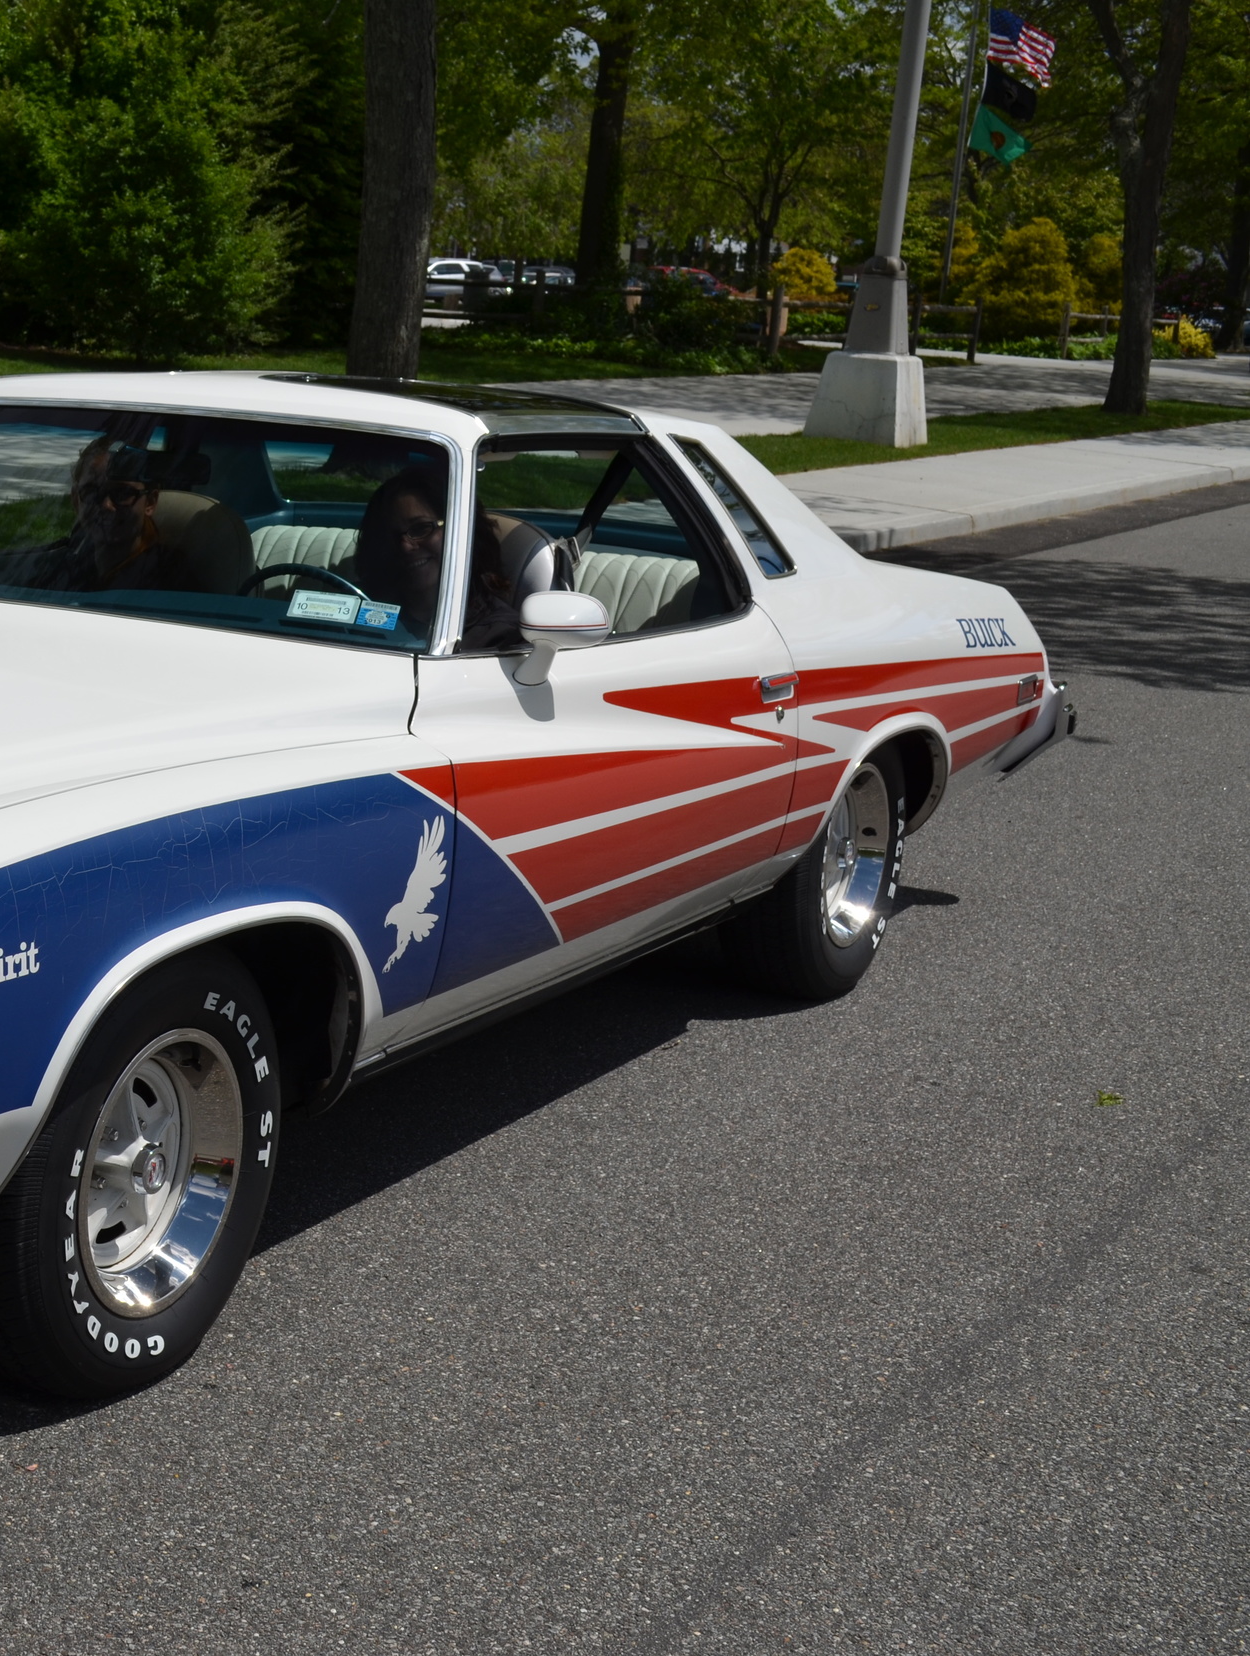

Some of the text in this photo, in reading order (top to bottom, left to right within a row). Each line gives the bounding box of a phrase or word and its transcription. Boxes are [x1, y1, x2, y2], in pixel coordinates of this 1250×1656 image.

[297, 602, 309, 611] 10
[337, 606, 351, 616] 13
[955, 617, 1017, 649] BUICK
[871, 796, 905, 949] EAGLE ST
[203, 991, 273, 1168] EAGLE ST
[64, 1147, 166, 1360] GOODYEAR
